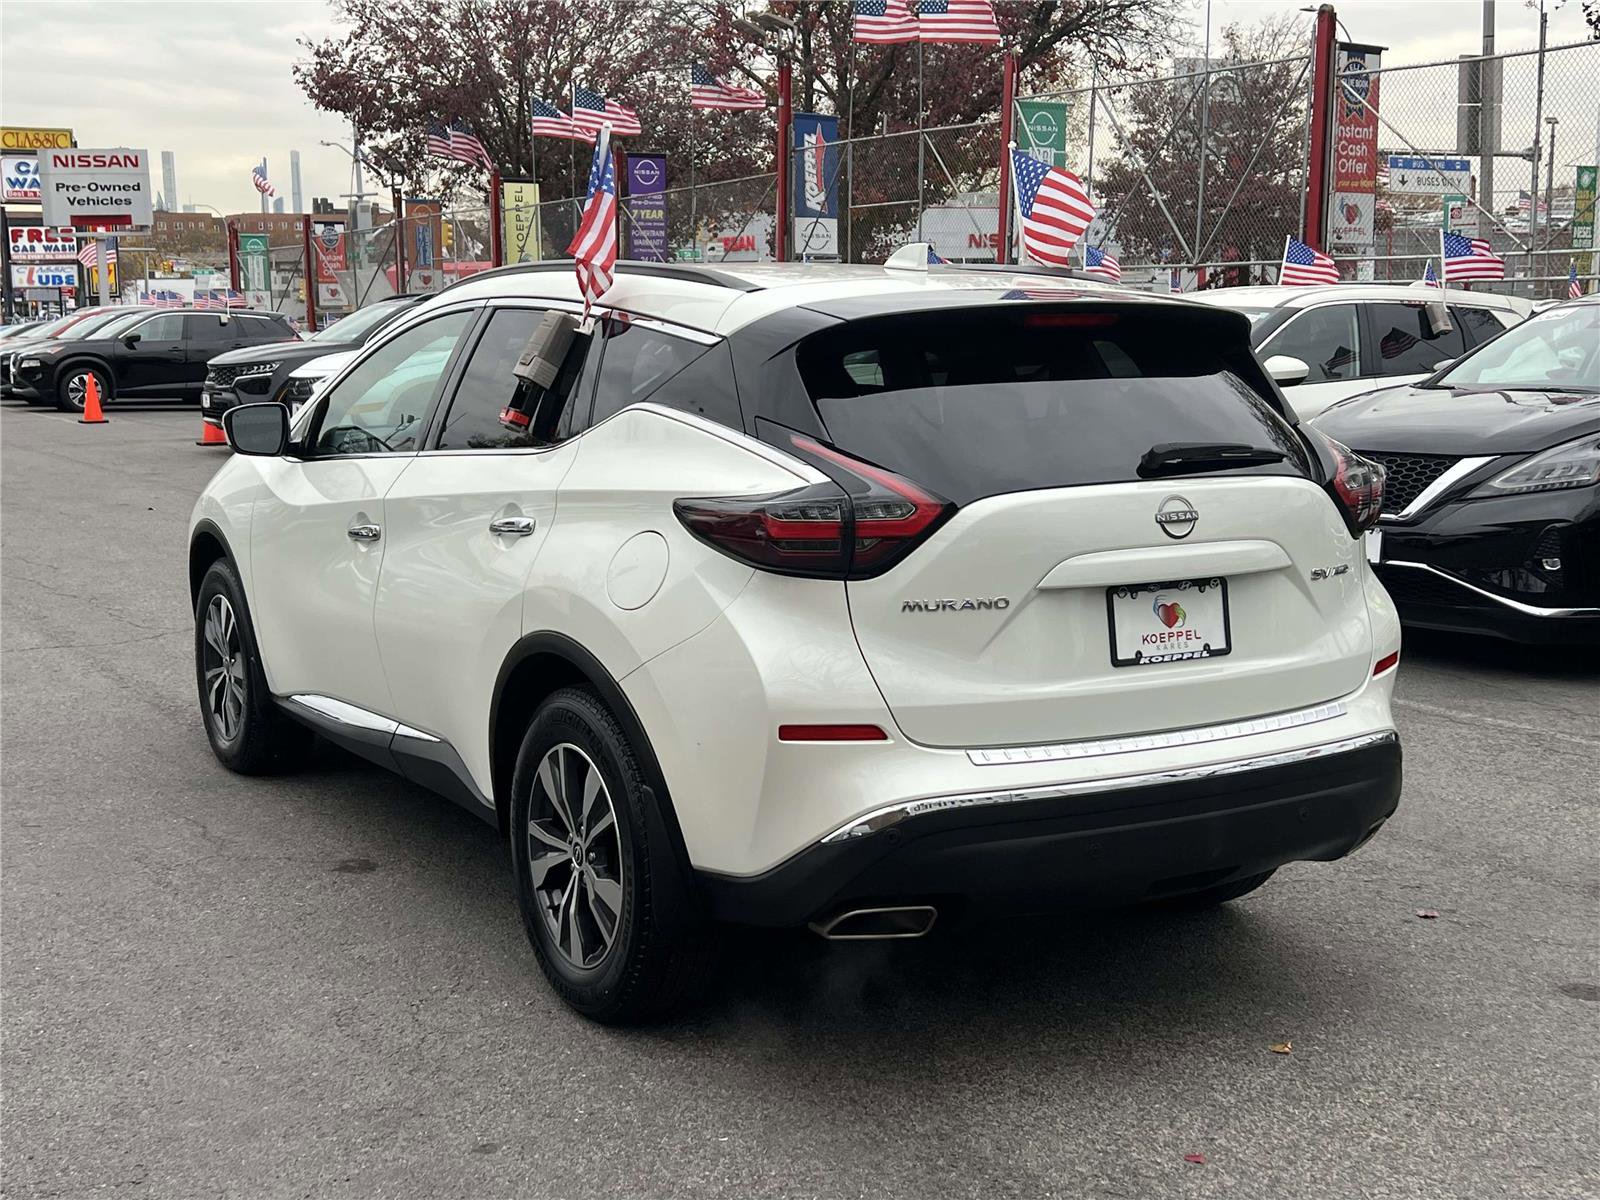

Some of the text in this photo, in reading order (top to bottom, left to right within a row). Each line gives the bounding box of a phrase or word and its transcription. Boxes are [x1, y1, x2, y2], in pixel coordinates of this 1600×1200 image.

[1338, 124, 1373, 139] nstant
[2, 132, 68, 149] CLASSIC
[1338, 141, 1368, 156] Cash
[53, 155, 139, 168] NISSAN
[1338, 158, 1367, 173] Offer
[55, 182, 141, 192] Pre-Owned
[1416, 176, 1440, 187] BUSES
[66, 196, 132, 206] Vehicles
[514, 186, 525, 253] KOEPPEL
[632, 209, 664, 220] 7 YEAR
[12, 244, 75, 253] CAR WASH
[1157, 512, 1199, 522] NISSAN
[1311, 567, 1330, 580] SV
[902, 596, 1010, 613] MURANO
[1141, 630, 1202, 645] KOEPPEL
[1156, 641, 1189, 651] KARES
[1139, 650, 1210, 664] KOEPPEL
